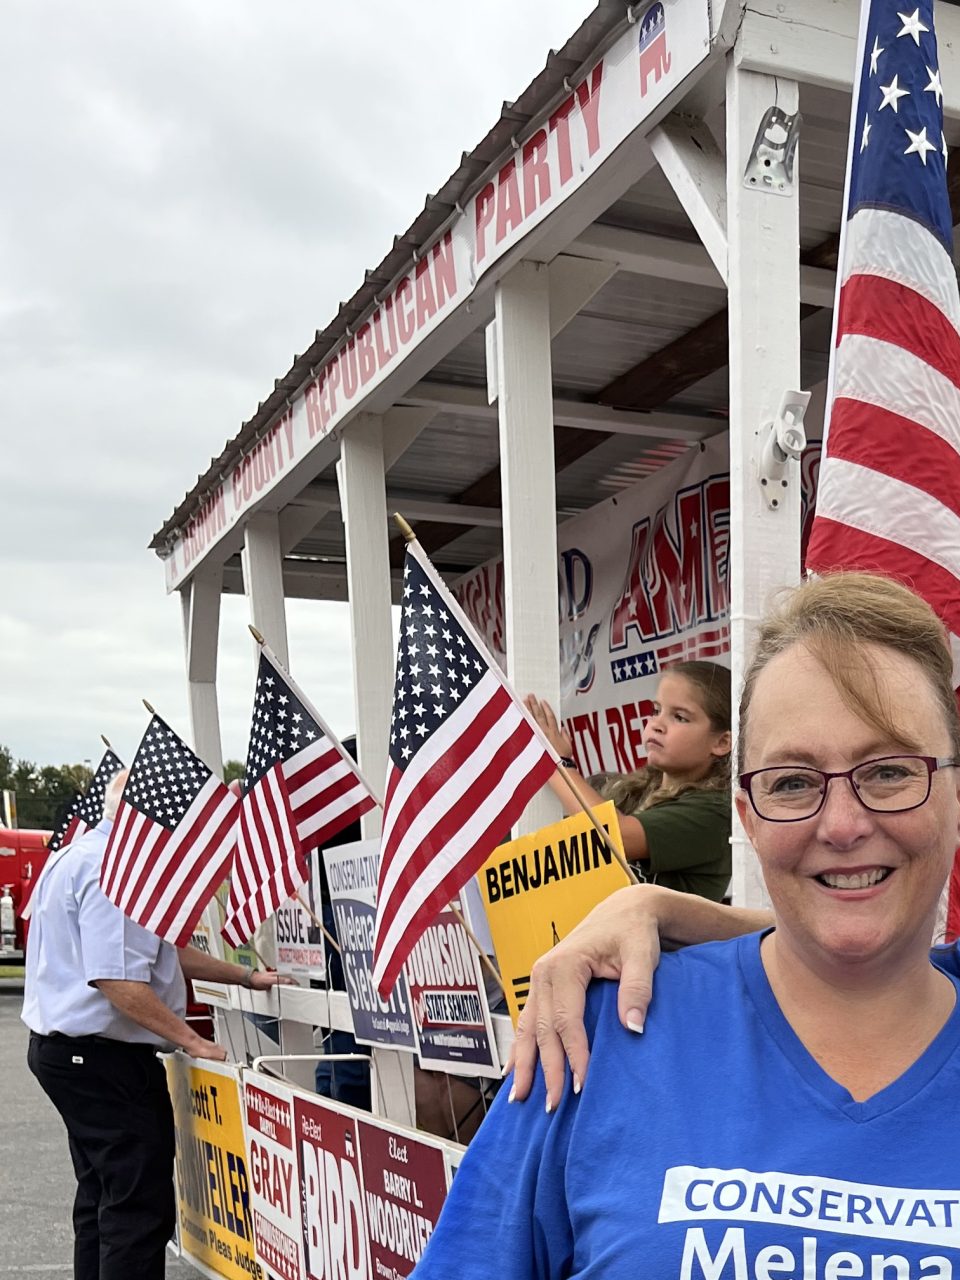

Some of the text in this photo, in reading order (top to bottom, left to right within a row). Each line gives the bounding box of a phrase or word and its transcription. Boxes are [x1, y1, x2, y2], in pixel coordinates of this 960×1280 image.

[232, 406, 295, 511] COUNTY
[304, 228, 458, 440] REPUBLICAN
[475, 59, 604, 264] PARTY
[330, 854, 381, 893] CONSERVATIV
[486, 824, 612, 904] BENJAMIN
[276, 908, 305, 944] ISSUE
[336, 904, 375, 951] Melena
[408, 923, 477, 987] JOHNSON
[425, 993, 449, 1020] STATE
[449, 994, 482, 1023] SENATOR
[210, 1085, 222, 1125] T.
[388, 1135, 409, 1164] Elect
[250, 1138, 292, 1219] GRAY
[383, 1169, 424, 1209] BARRY L.
[208, 1228, 232, 1261] Pleas
